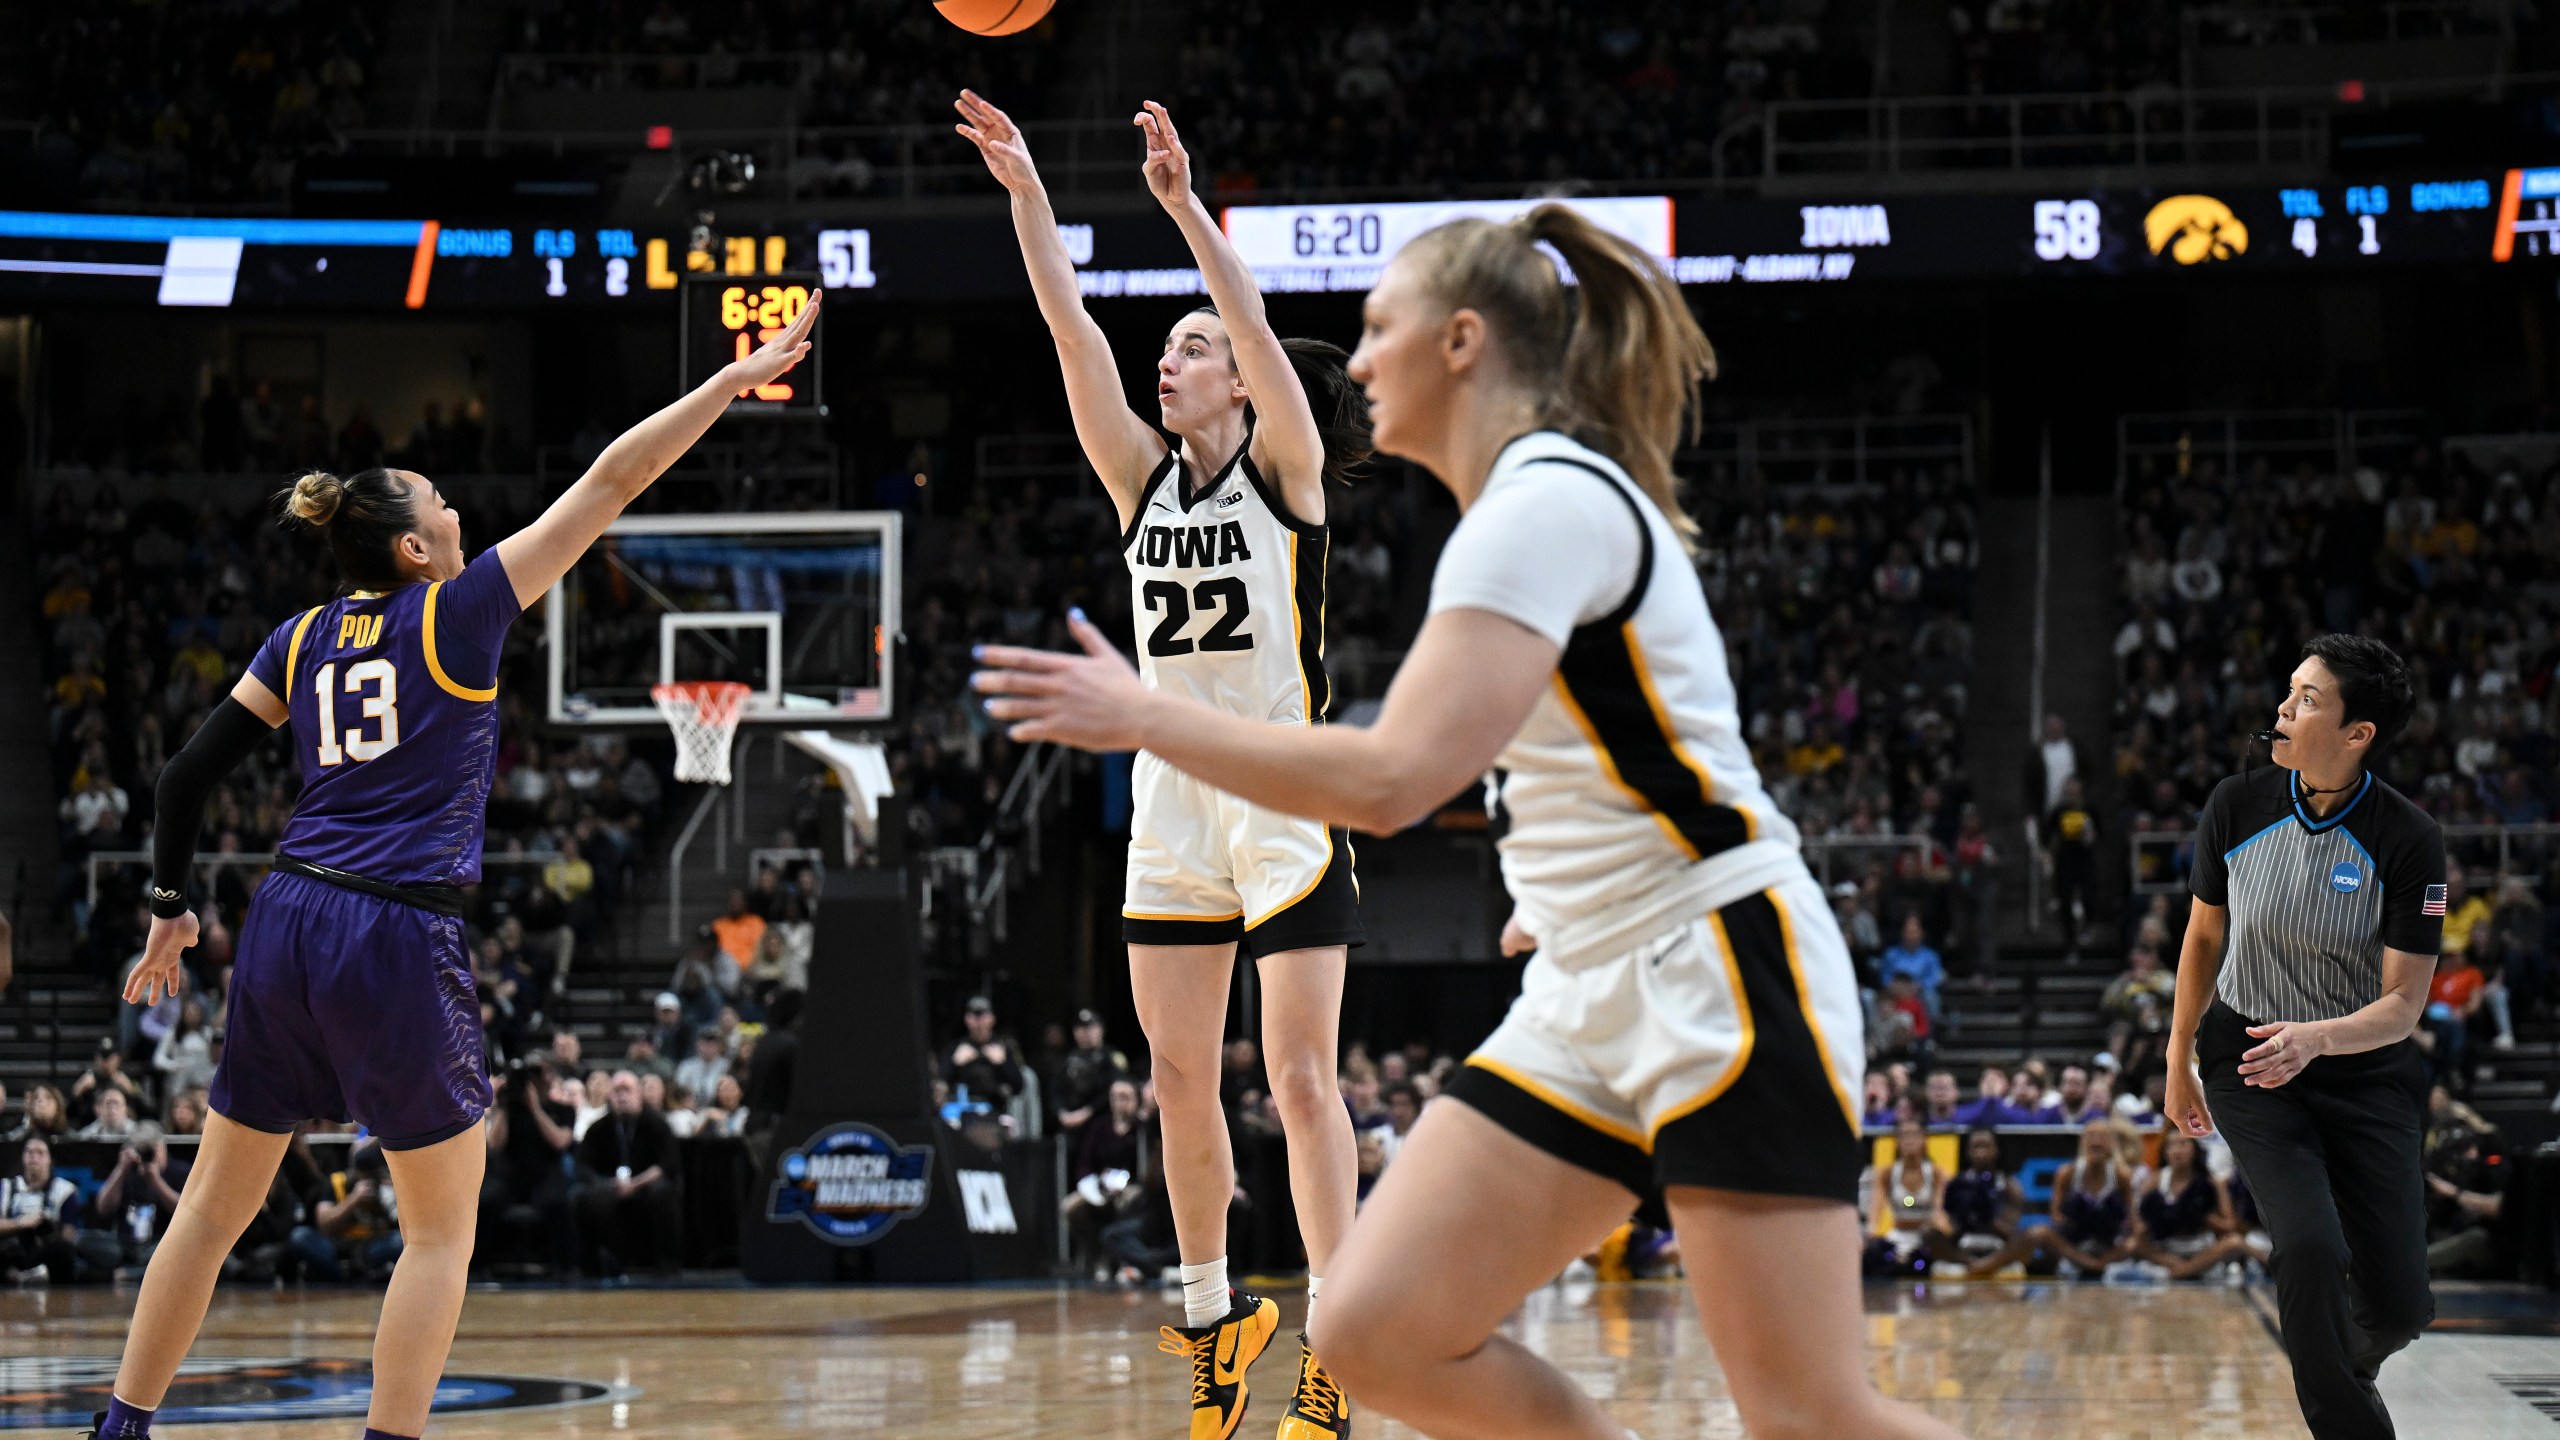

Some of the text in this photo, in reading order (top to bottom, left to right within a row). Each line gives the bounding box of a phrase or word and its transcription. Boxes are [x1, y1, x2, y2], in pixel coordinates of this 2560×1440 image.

[2346, 185, 2388, 216] FLS
[2411, 180, 2489, 212] BONUS
[437, 229, 513, 258] BONUS
[534, 229, 576, 258] FLS
[1295, 214, 1381, 256] 6:20
[1801, 205, 1890, 248] IOWA
[2034, 200, 2101, 261] 58
[2291, 215, 2381, 258] 4 1
[546, 257, 629, 297] 1 2
[818, 229, 877, 289] 51
[721, 286, 809, 330] 6:20
[1136, 520, 1252, 569] IOWA
[336, 614, 385, 649] POA
[1142, 576, 1254, 657] 22
[315, 658, 399, 767] 13
[2333, 874, 2359, 887] NCAA
[807, 1153, 891, 1179] MARCH
[814, 1178, 928, 1208] MADNESS
